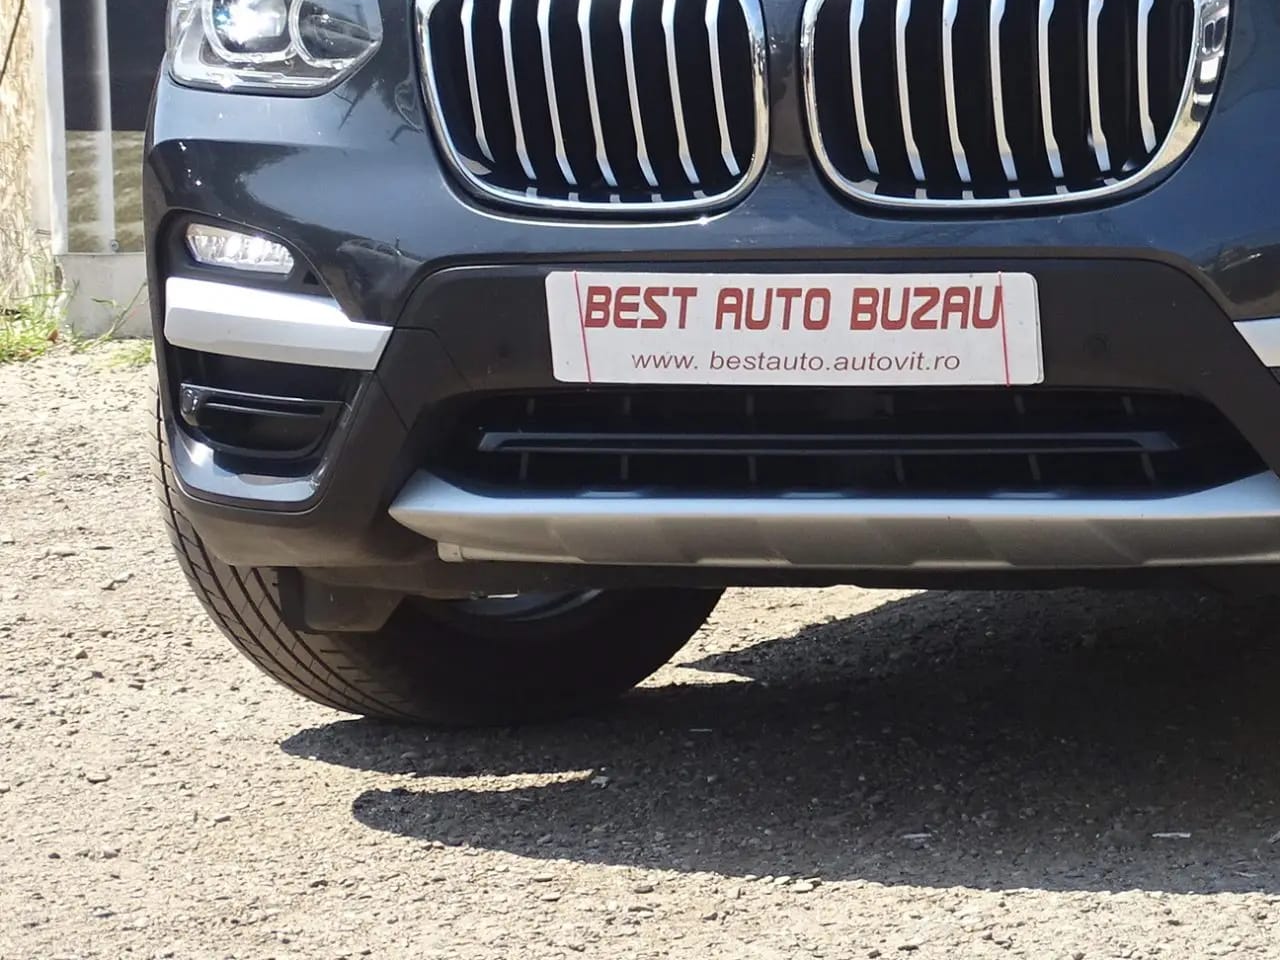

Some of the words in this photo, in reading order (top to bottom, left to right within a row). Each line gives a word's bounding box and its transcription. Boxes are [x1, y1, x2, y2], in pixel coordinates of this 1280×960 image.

[584, 285, 698, 329] BEST
[714, 287, 832, 330] AUTO
[848, 285, 1004, 330] BUZAU
